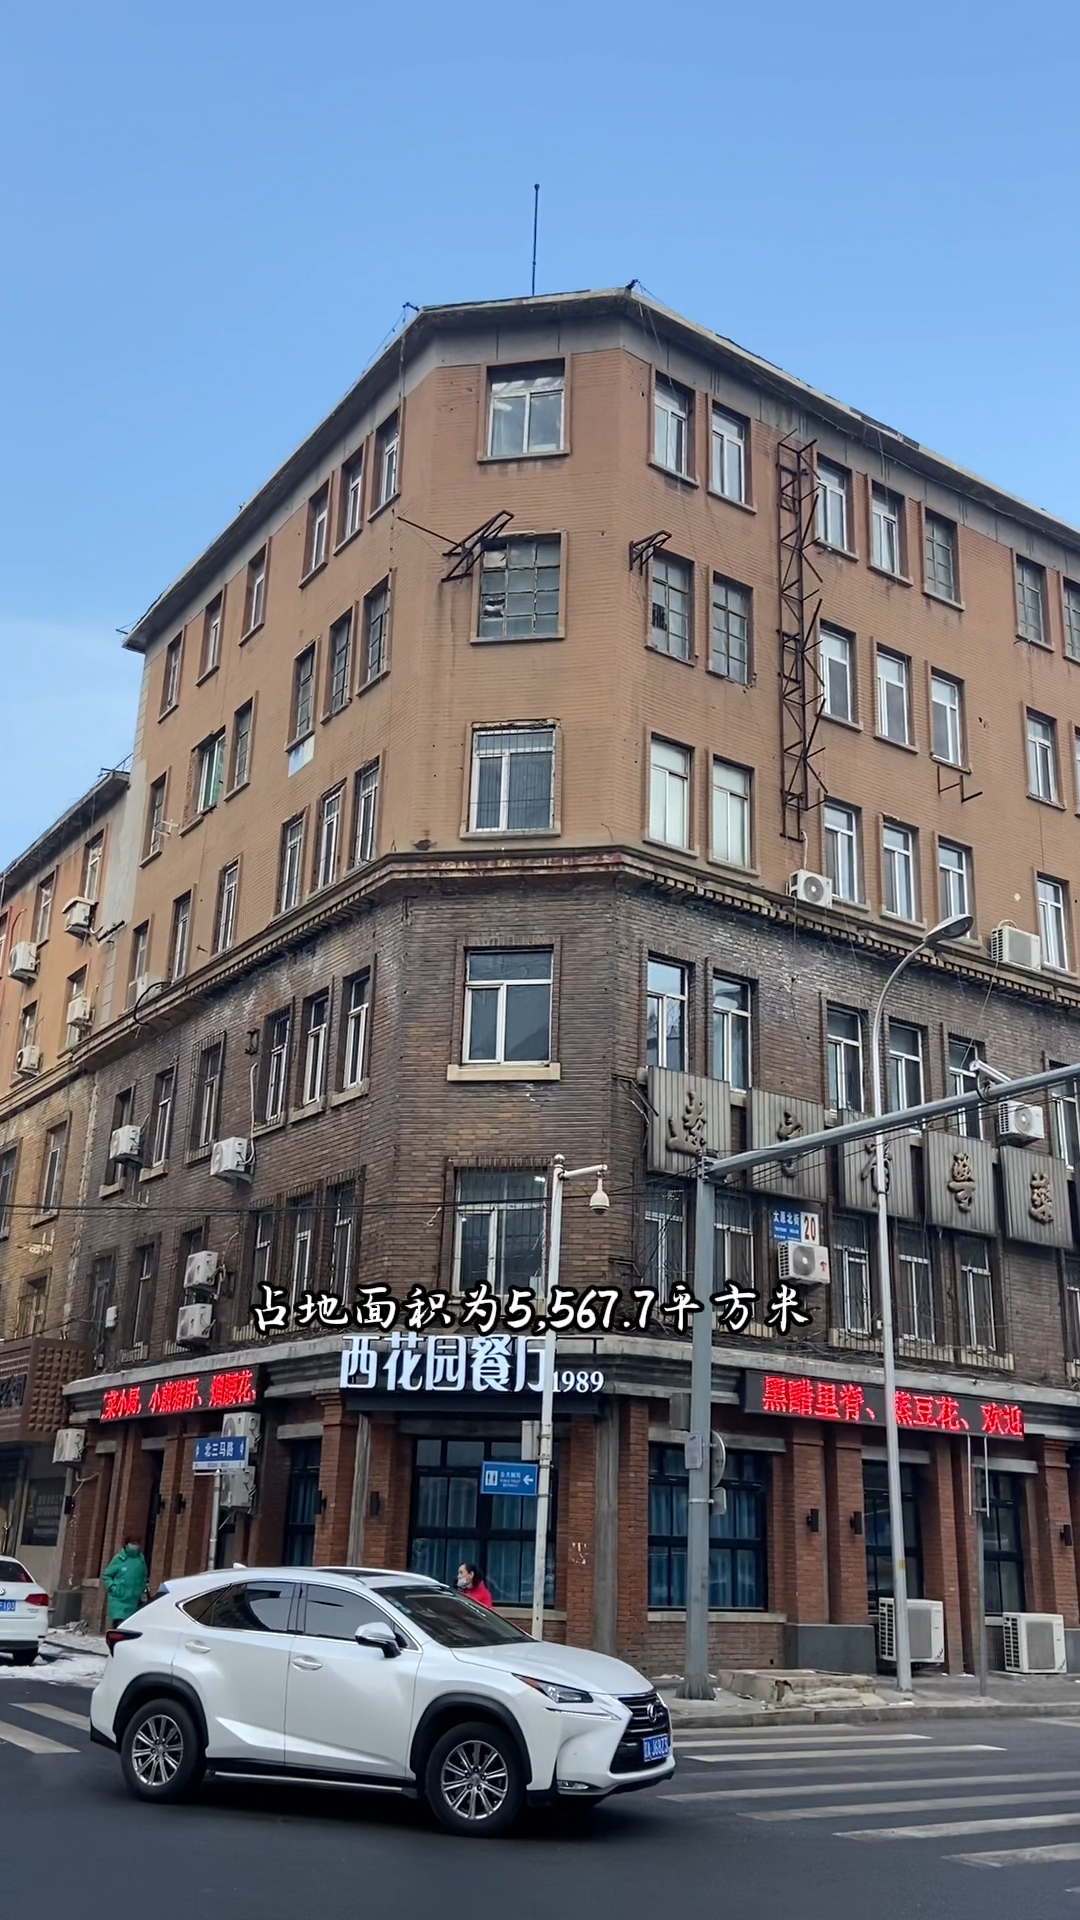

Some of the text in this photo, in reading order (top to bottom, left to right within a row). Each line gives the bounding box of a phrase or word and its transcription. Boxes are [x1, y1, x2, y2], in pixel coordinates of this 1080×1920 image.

[804, 1215, 816, 1241] 20
[340, 1332, 549, 1392] 西花园餐厅
[553, 1370, 605, 1393] 1989
[204, 1441, 234, 1457] 北三马路
